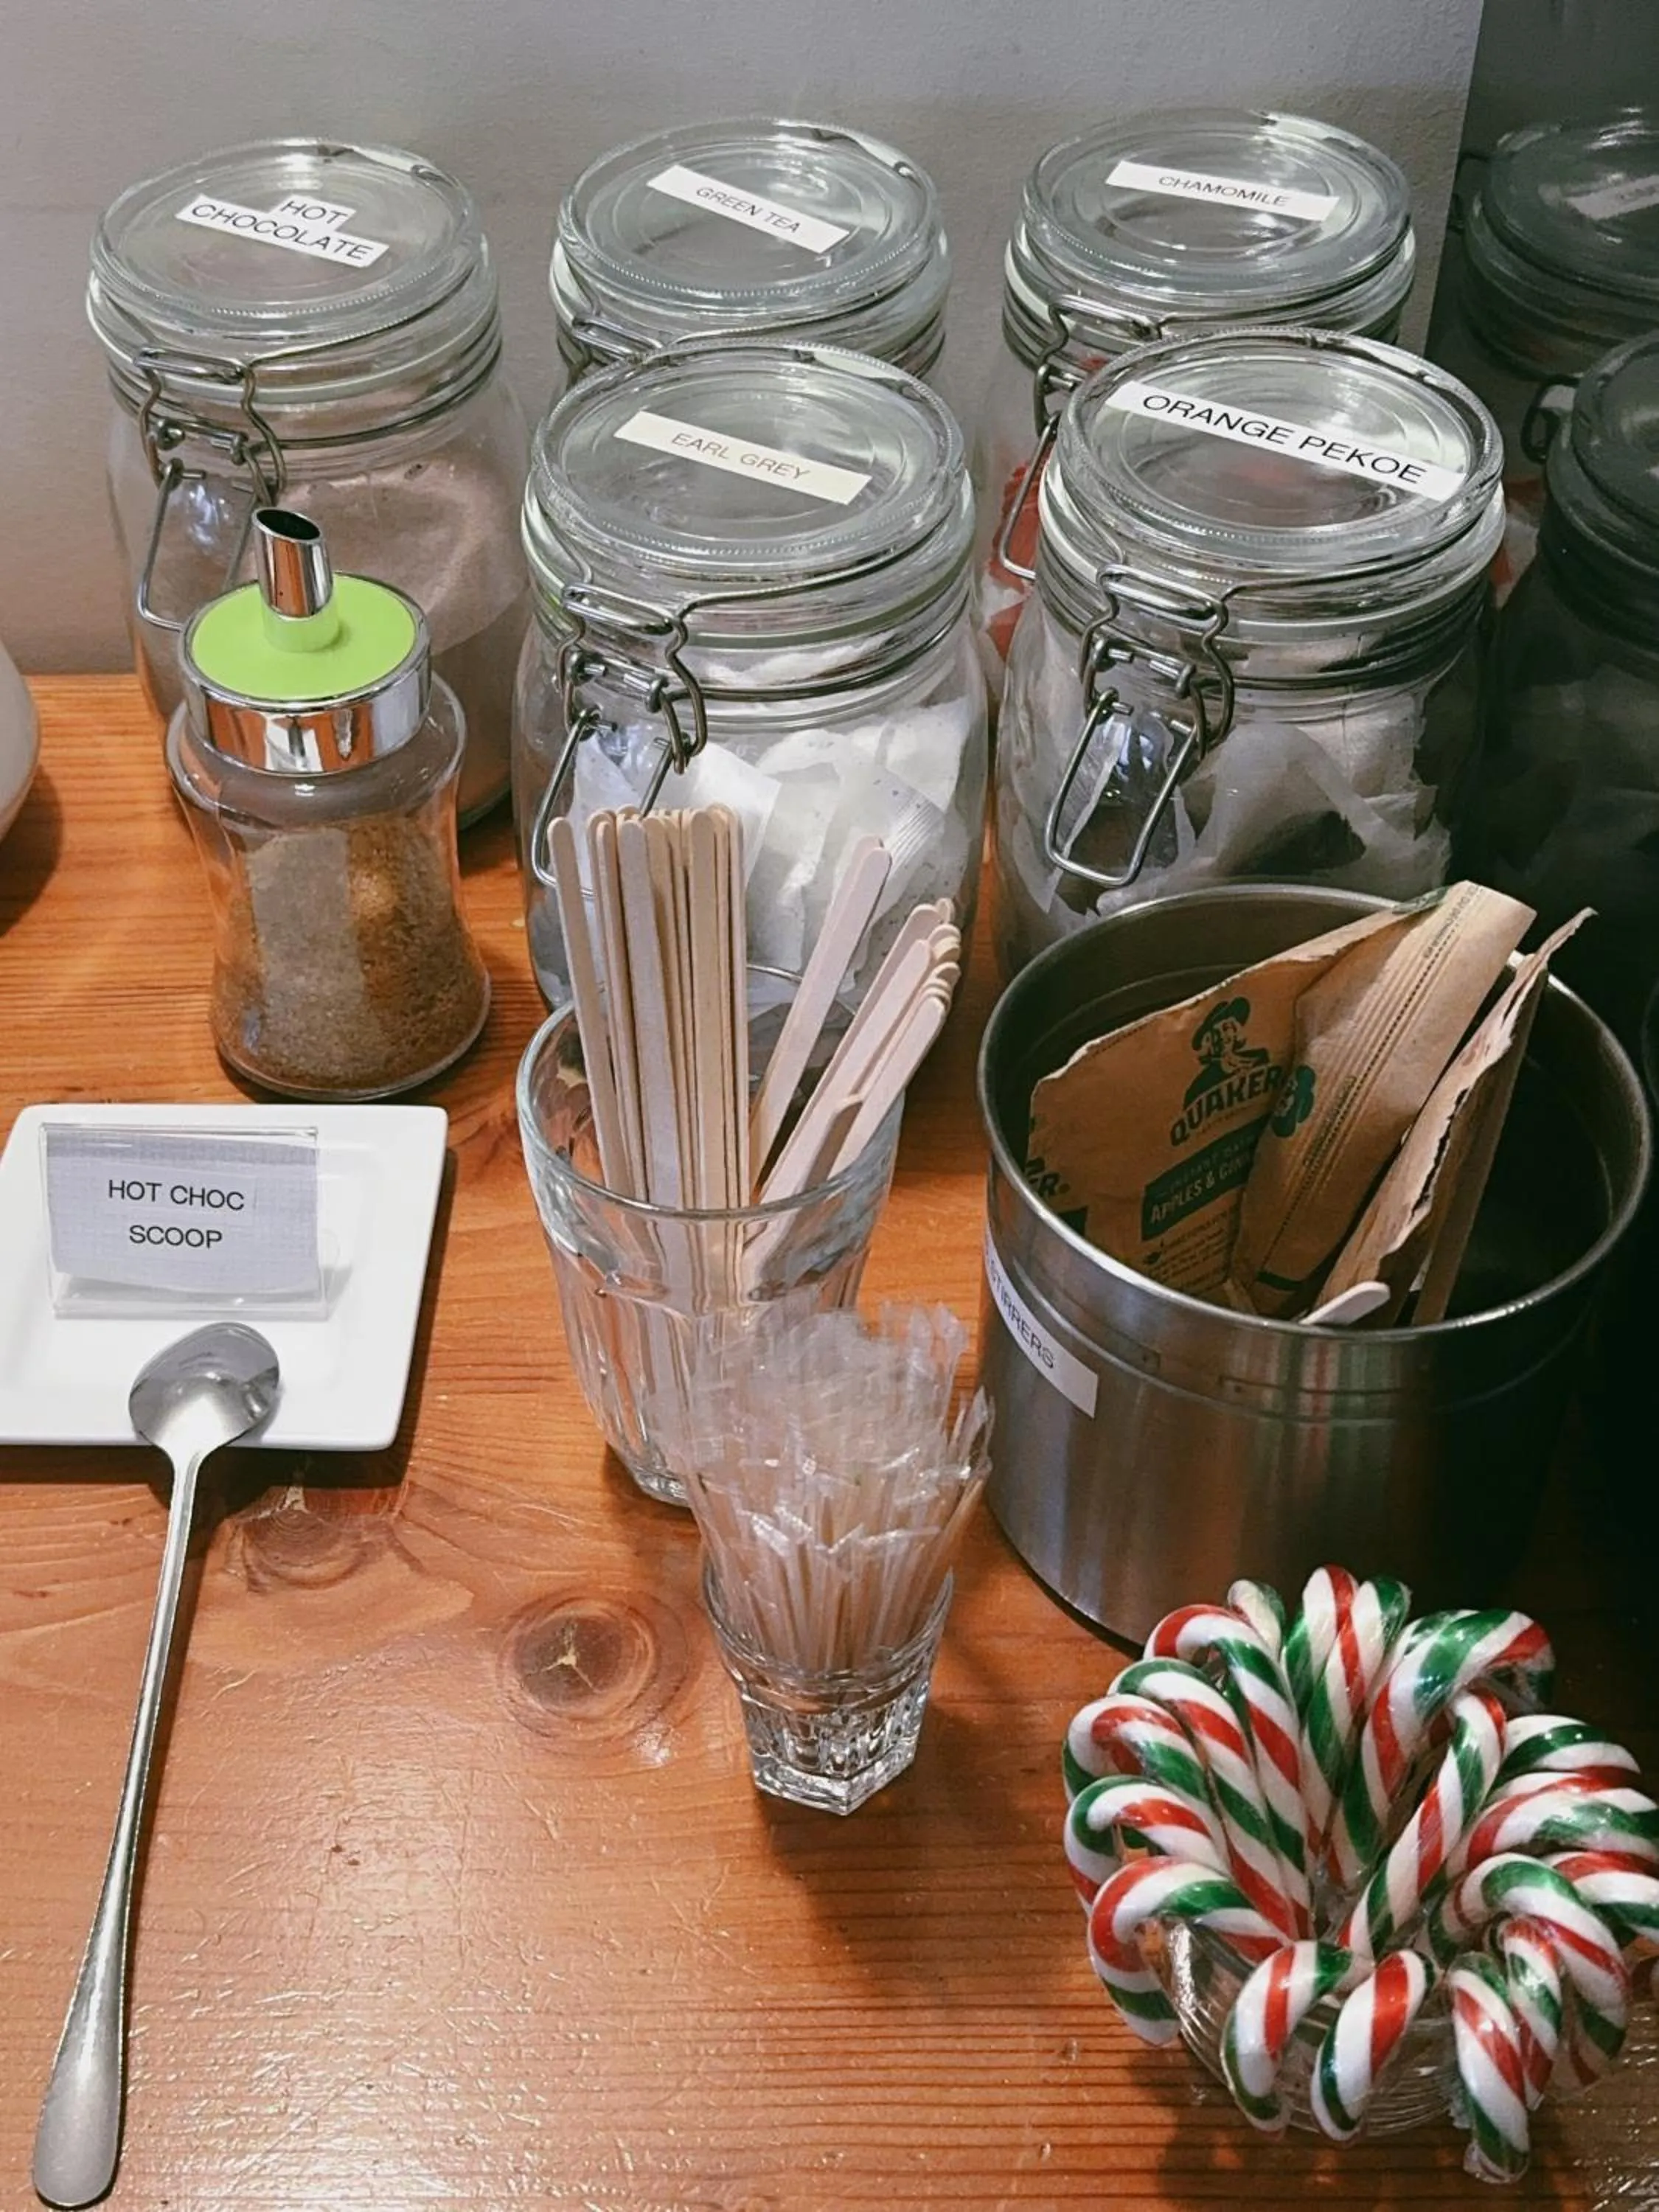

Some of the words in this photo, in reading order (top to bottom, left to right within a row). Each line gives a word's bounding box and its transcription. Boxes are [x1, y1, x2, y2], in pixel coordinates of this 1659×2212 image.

[280, 200, 349, 224] HOT
[695, 187, 762, 216] GREEN
[765, 212, 800, 232] TEA
[1159, 177, 1291, 205] CHAMOMILE
[192, 204, 373, 260] CHOCOLATE
[672, 434, 731, 459] EARL
[740, 454, 810, 479] GREY
[1143, 394, 1295, 444] ORANGE
[1298, 436, 1427, 484] PEKOE
[1169, 1065, 1284, 1147] QUAKER
[109, 1180, 163, 1203] HOT
[170, 1185, 245, 1211] CHOC
[130, 1225, 223, 1249] SCOOP
